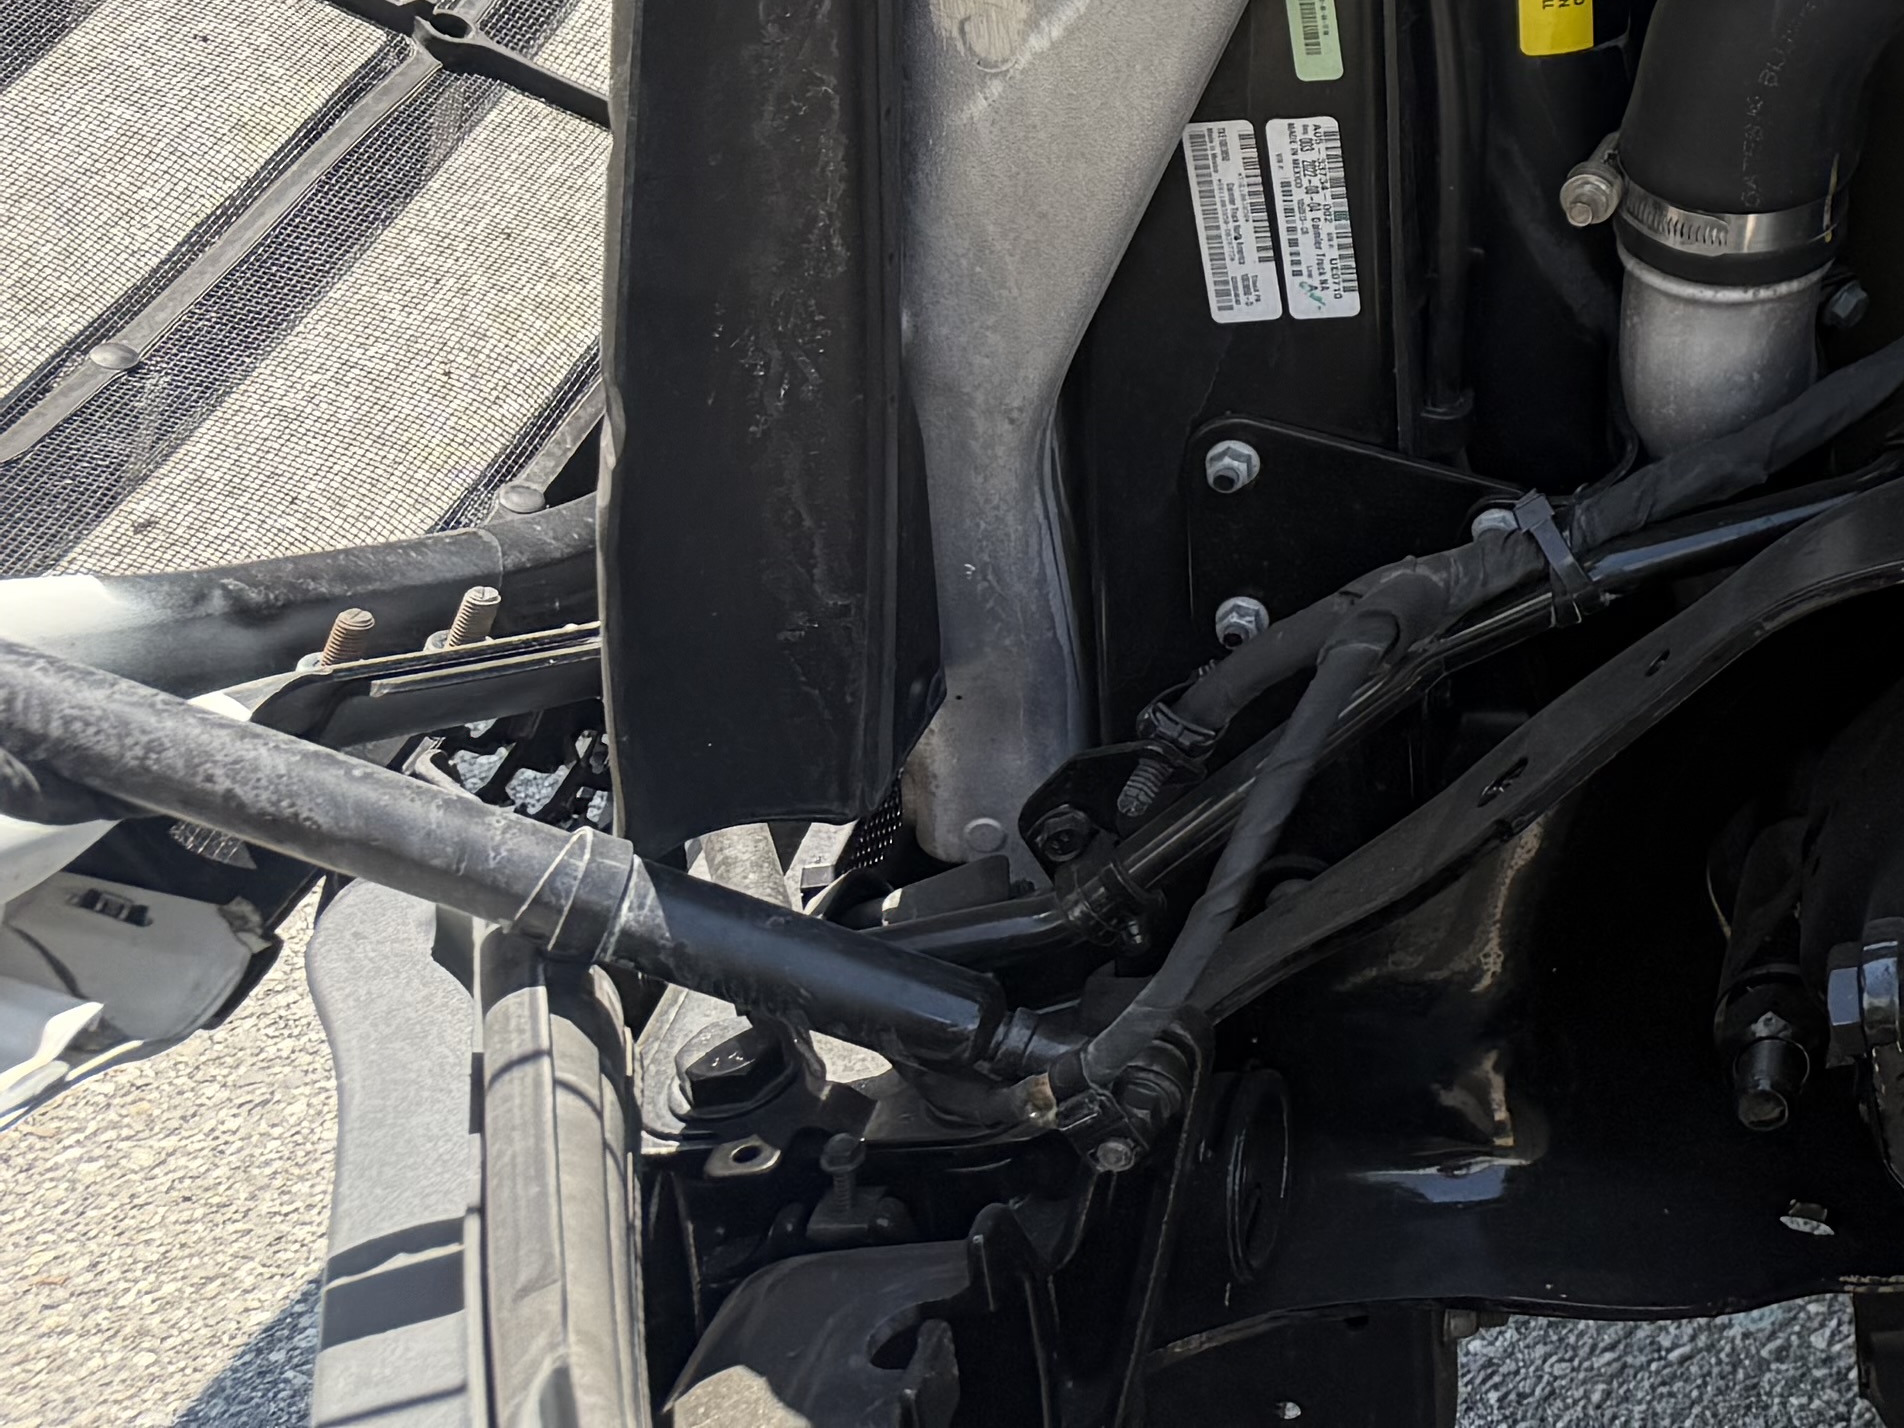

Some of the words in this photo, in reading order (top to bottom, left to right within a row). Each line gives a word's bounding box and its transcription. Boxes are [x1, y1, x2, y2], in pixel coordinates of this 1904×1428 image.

[1311, 217, 1326, 250] Daimler
[1315, 253, 1327, 276] Truck
[1329, 258, 1343, 300] UE0710
